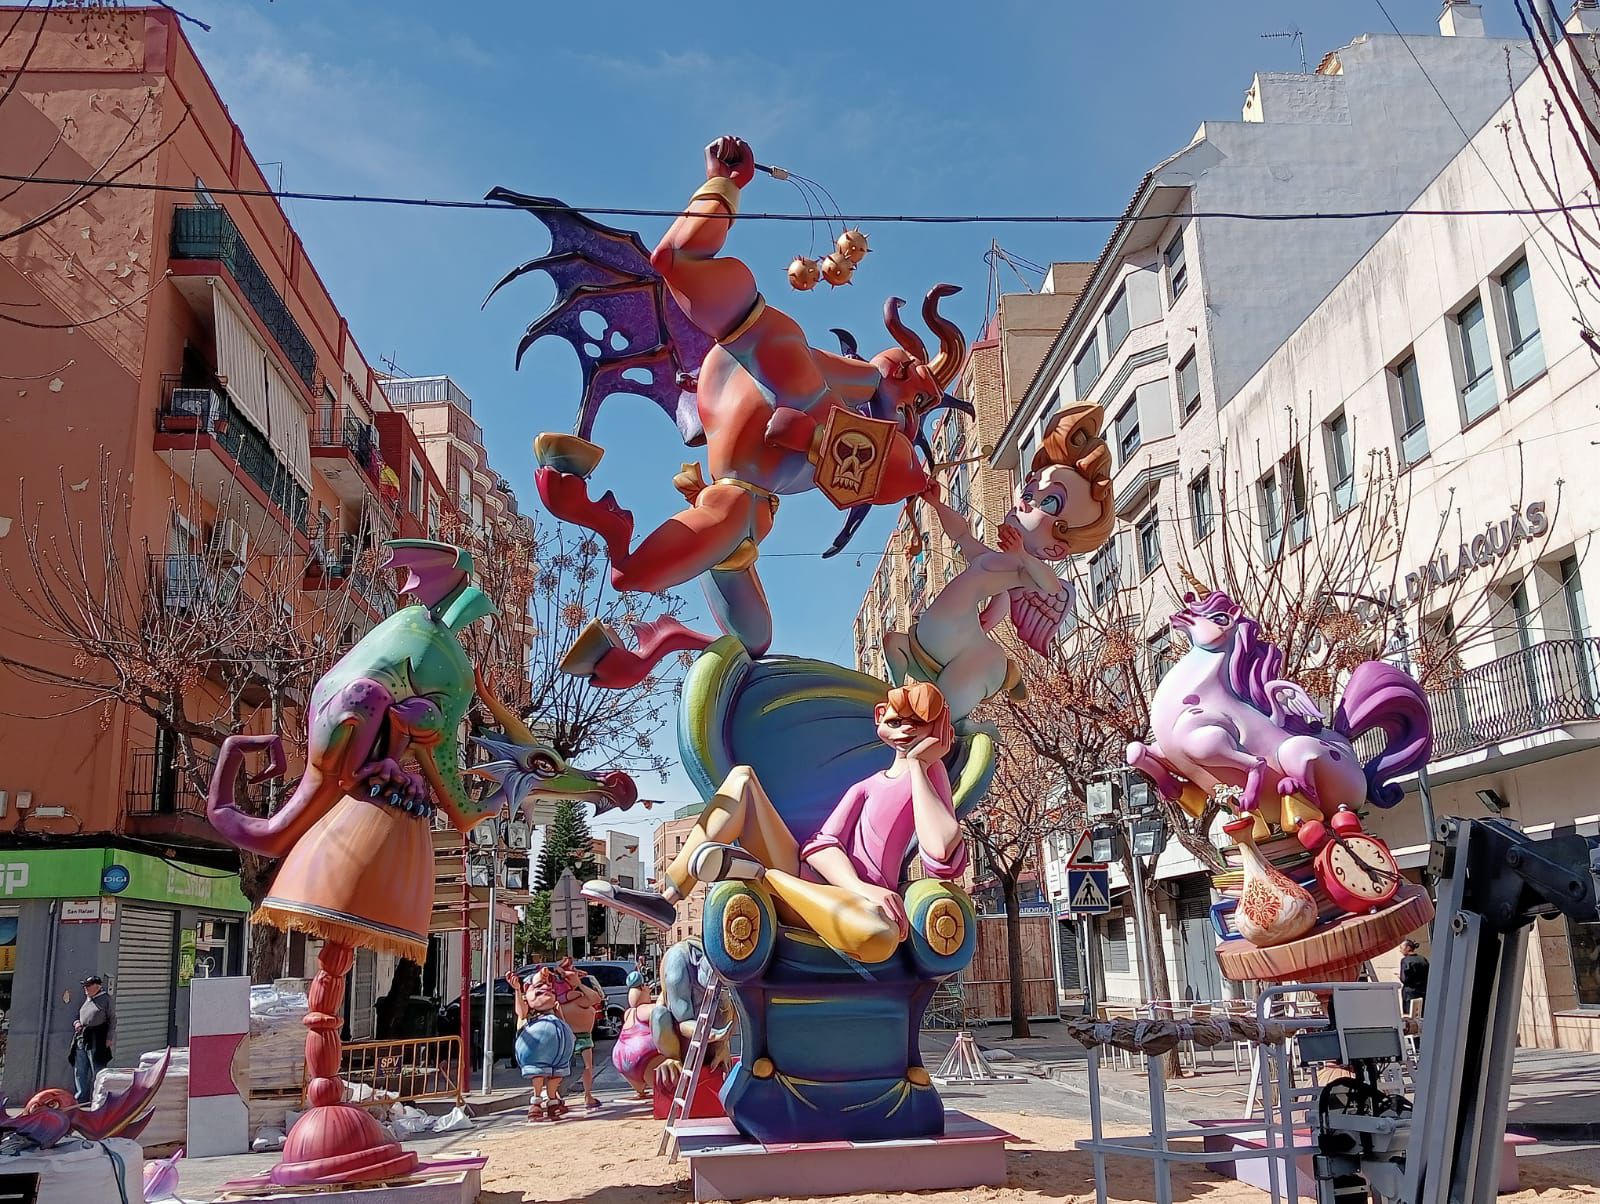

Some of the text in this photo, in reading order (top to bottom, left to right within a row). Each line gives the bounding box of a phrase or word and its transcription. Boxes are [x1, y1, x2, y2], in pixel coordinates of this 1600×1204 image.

[1373, 850, 1385, 864] 3
[1335, 866, 1347, 882] 9
[1371, 881, 1383, 894] 6
[380, 1056, 400, 1068] SPV
